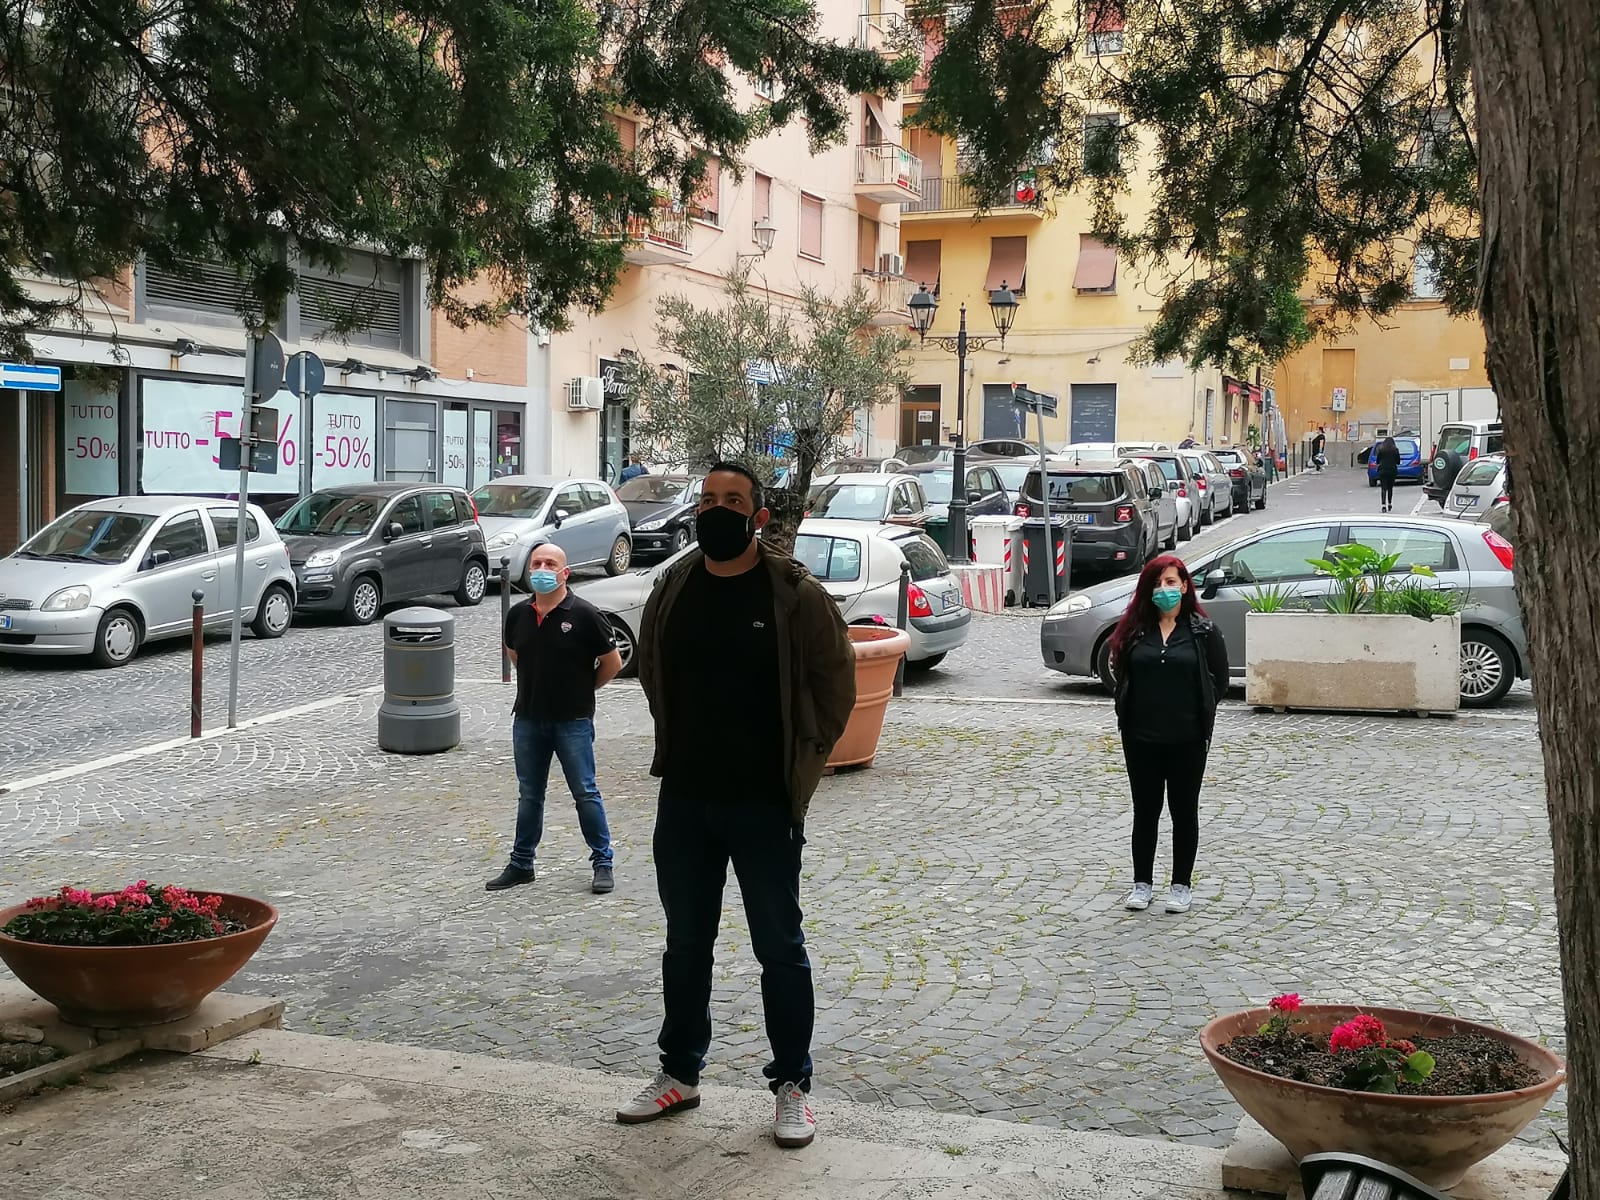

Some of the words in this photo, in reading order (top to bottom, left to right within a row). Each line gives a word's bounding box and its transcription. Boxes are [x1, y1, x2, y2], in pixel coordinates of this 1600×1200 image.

[70, 405, 114, 419] TUTTO
[327, 413, 361, 430] TUTTO
[67, 436, 117, 460] -50%
[145, 430, 190, 449] TUTTO
[445, 435, 464, 446] TUTTO
[316, 435, 371, 469] -50%
[445, 454, 465, 469] -50%
